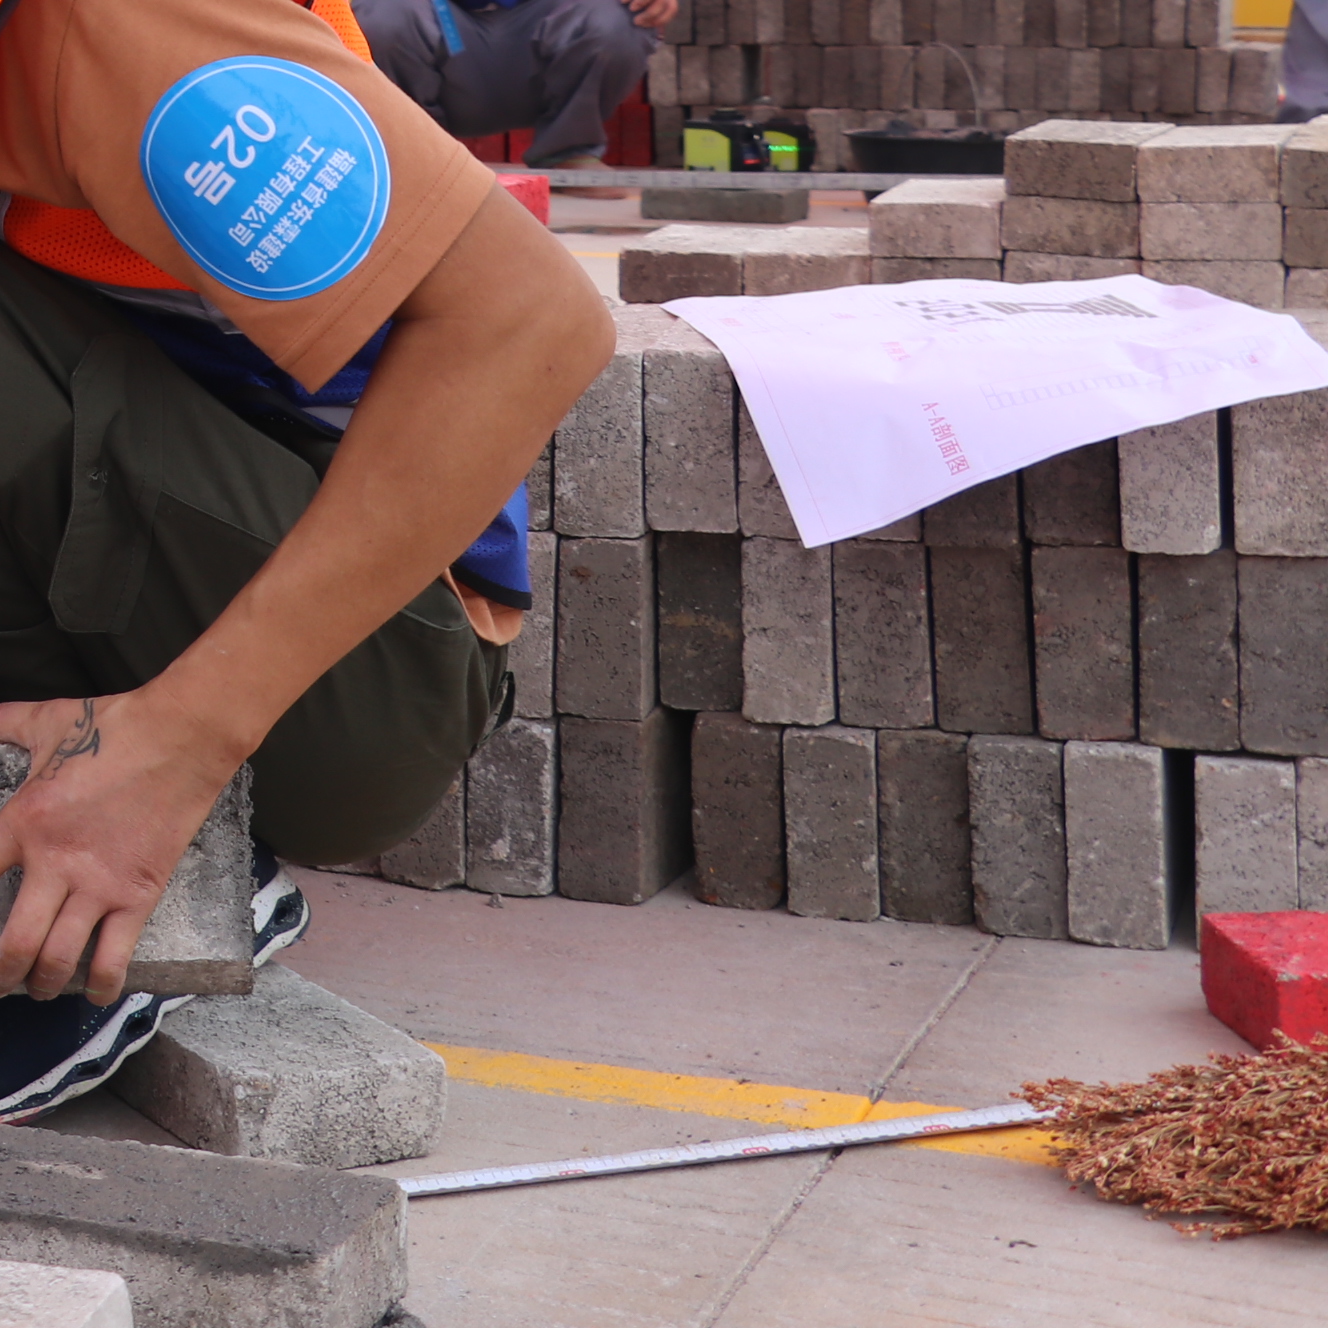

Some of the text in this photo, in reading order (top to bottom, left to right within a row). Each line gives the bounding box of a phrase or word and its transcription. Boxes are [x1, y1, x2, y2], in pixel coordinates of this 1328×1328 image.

[184, 104, 277, 206] 02号
[228, 135, 326, 248] 工程有限公司
